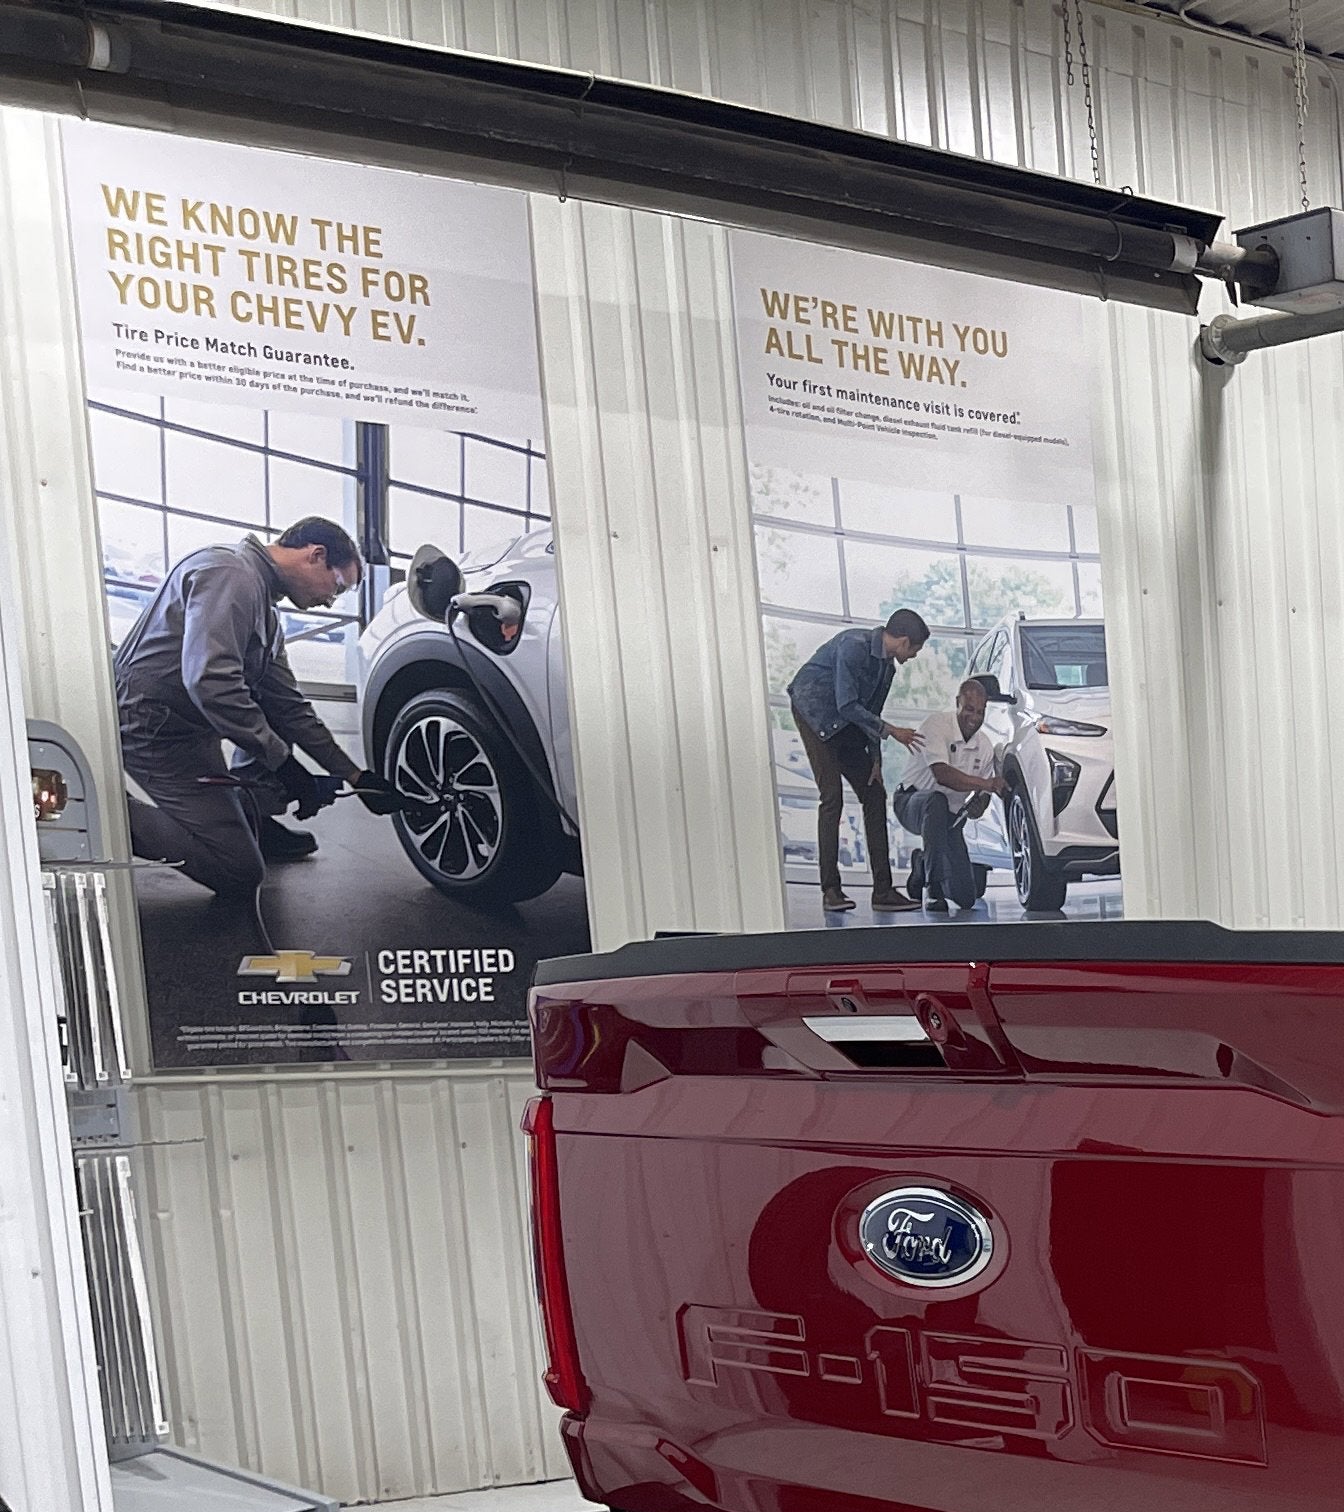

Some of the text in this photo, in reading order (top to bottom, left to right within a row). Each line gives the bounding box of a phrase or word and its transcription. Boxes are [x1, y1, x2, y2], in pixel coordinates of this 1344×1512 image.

[101, 184, 383, 258] WE KNOW THE
[107, 228, 430, 306] RIGHT TIRES FOR
[108, 271, 425, 346] YOUR CHEVY EV.
[867, 308, 944, 349] WITH
[951, 323, 1008, 358] YOU
[112, 322, 355, 370] Tire Price Match Guarantee.
[765, 327, 967, 388] ALL THE WAY.
[766, 372, 798, 391] Your
[802, 379, 832, 398] first
[836, 388, 920, 411] maintenance
[923, 400, 950, 416] visit
[954, 404, 964, 418] is
[378, 948, 516, 975] CERTIFIED
[238, 990, 360, 1005] CHEVROLET
[380, 977, 495, 1004] SERVICE
[882, 1207, 952, 1265] Ford
[677, 1303, 1268, 1467] F-150
